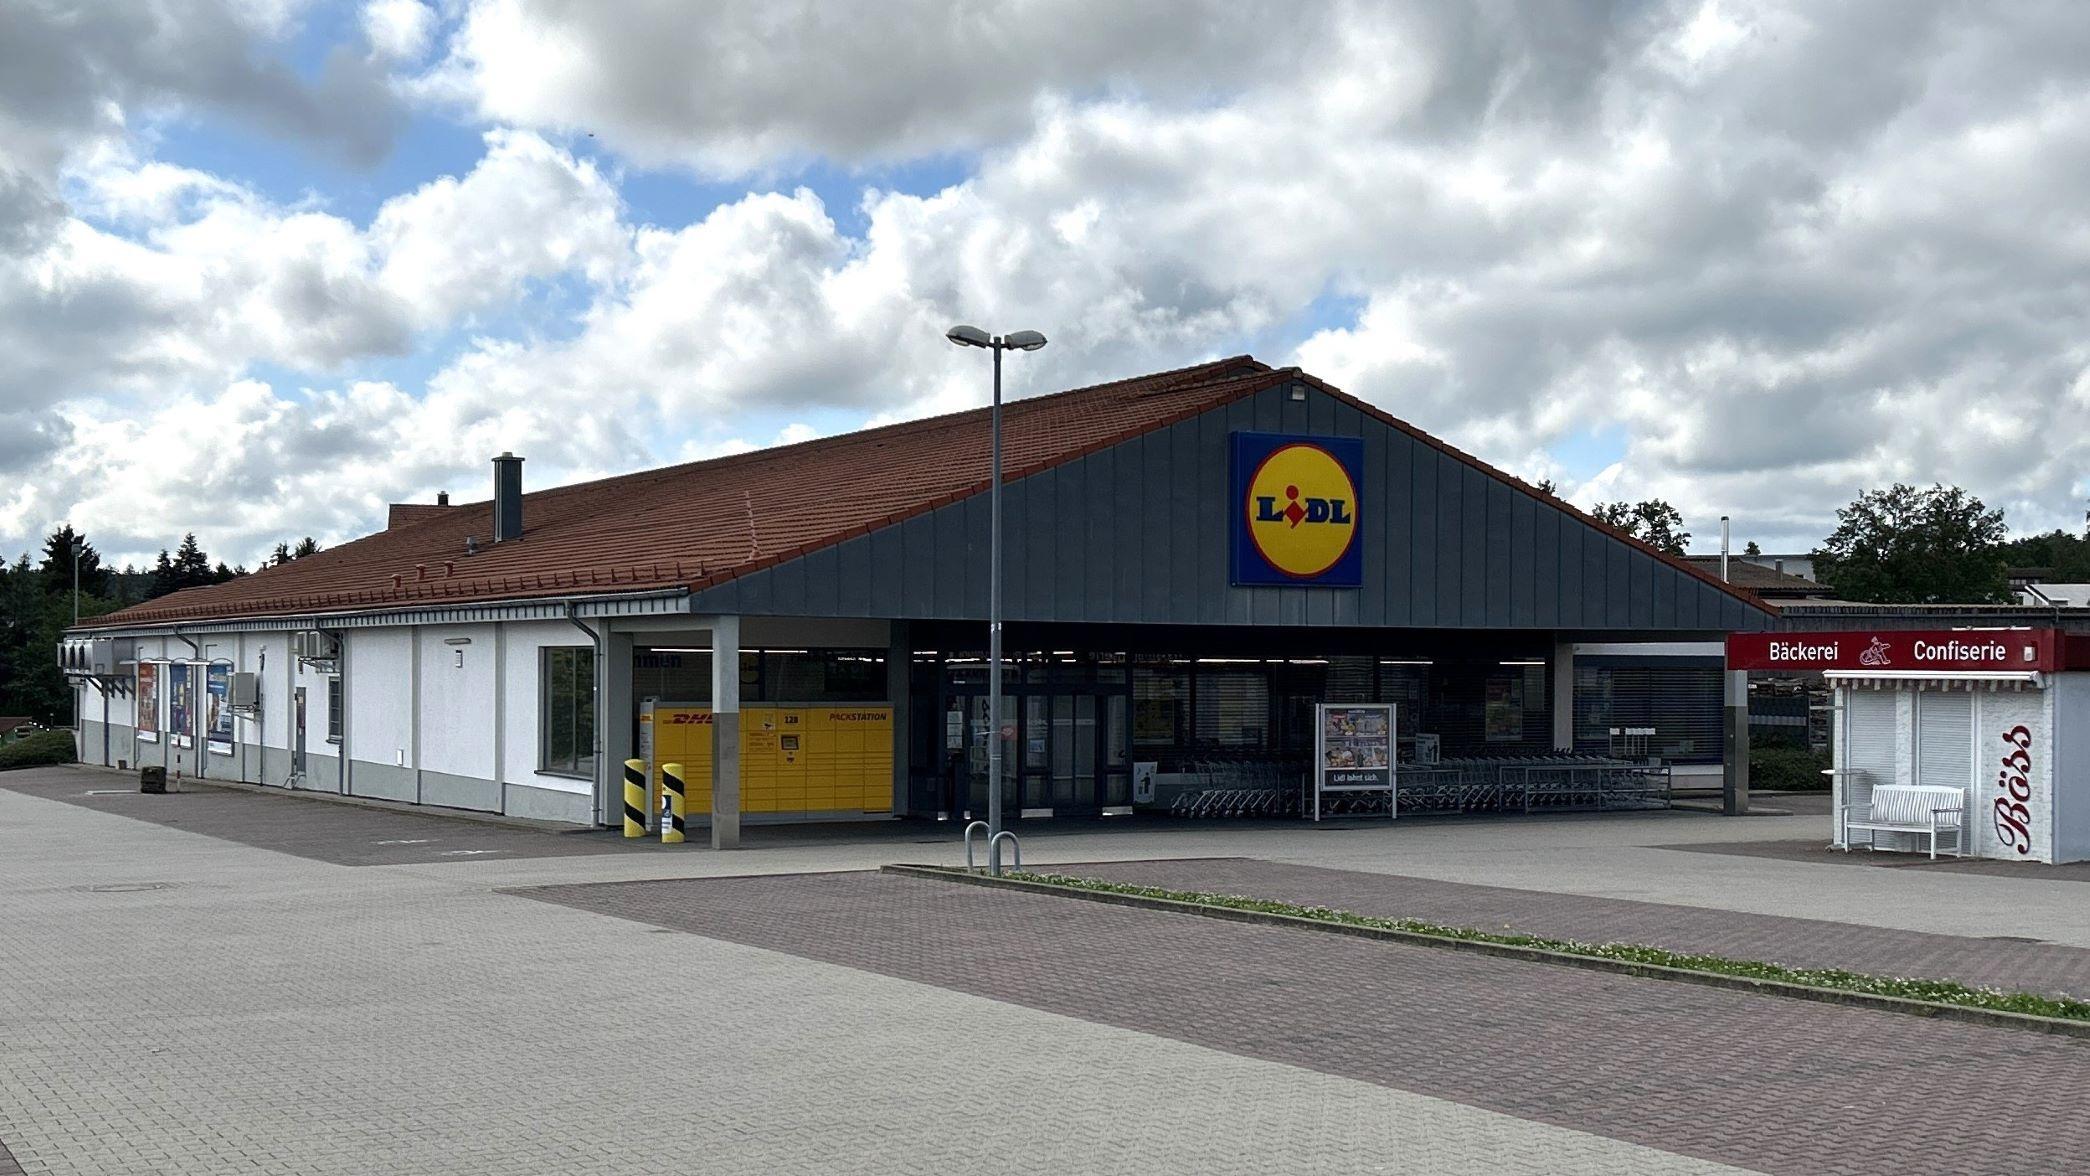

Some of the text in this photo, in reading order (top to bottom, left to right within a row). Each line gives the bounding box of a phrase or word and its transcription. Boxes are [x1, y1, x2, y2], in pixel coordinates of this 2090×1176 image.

[1769, 640, 2006, 661] Bäckerei Confiserie
[829, 713, 887, 721] PACKSTATION
[1994, 725, 2031, 854] Böss
